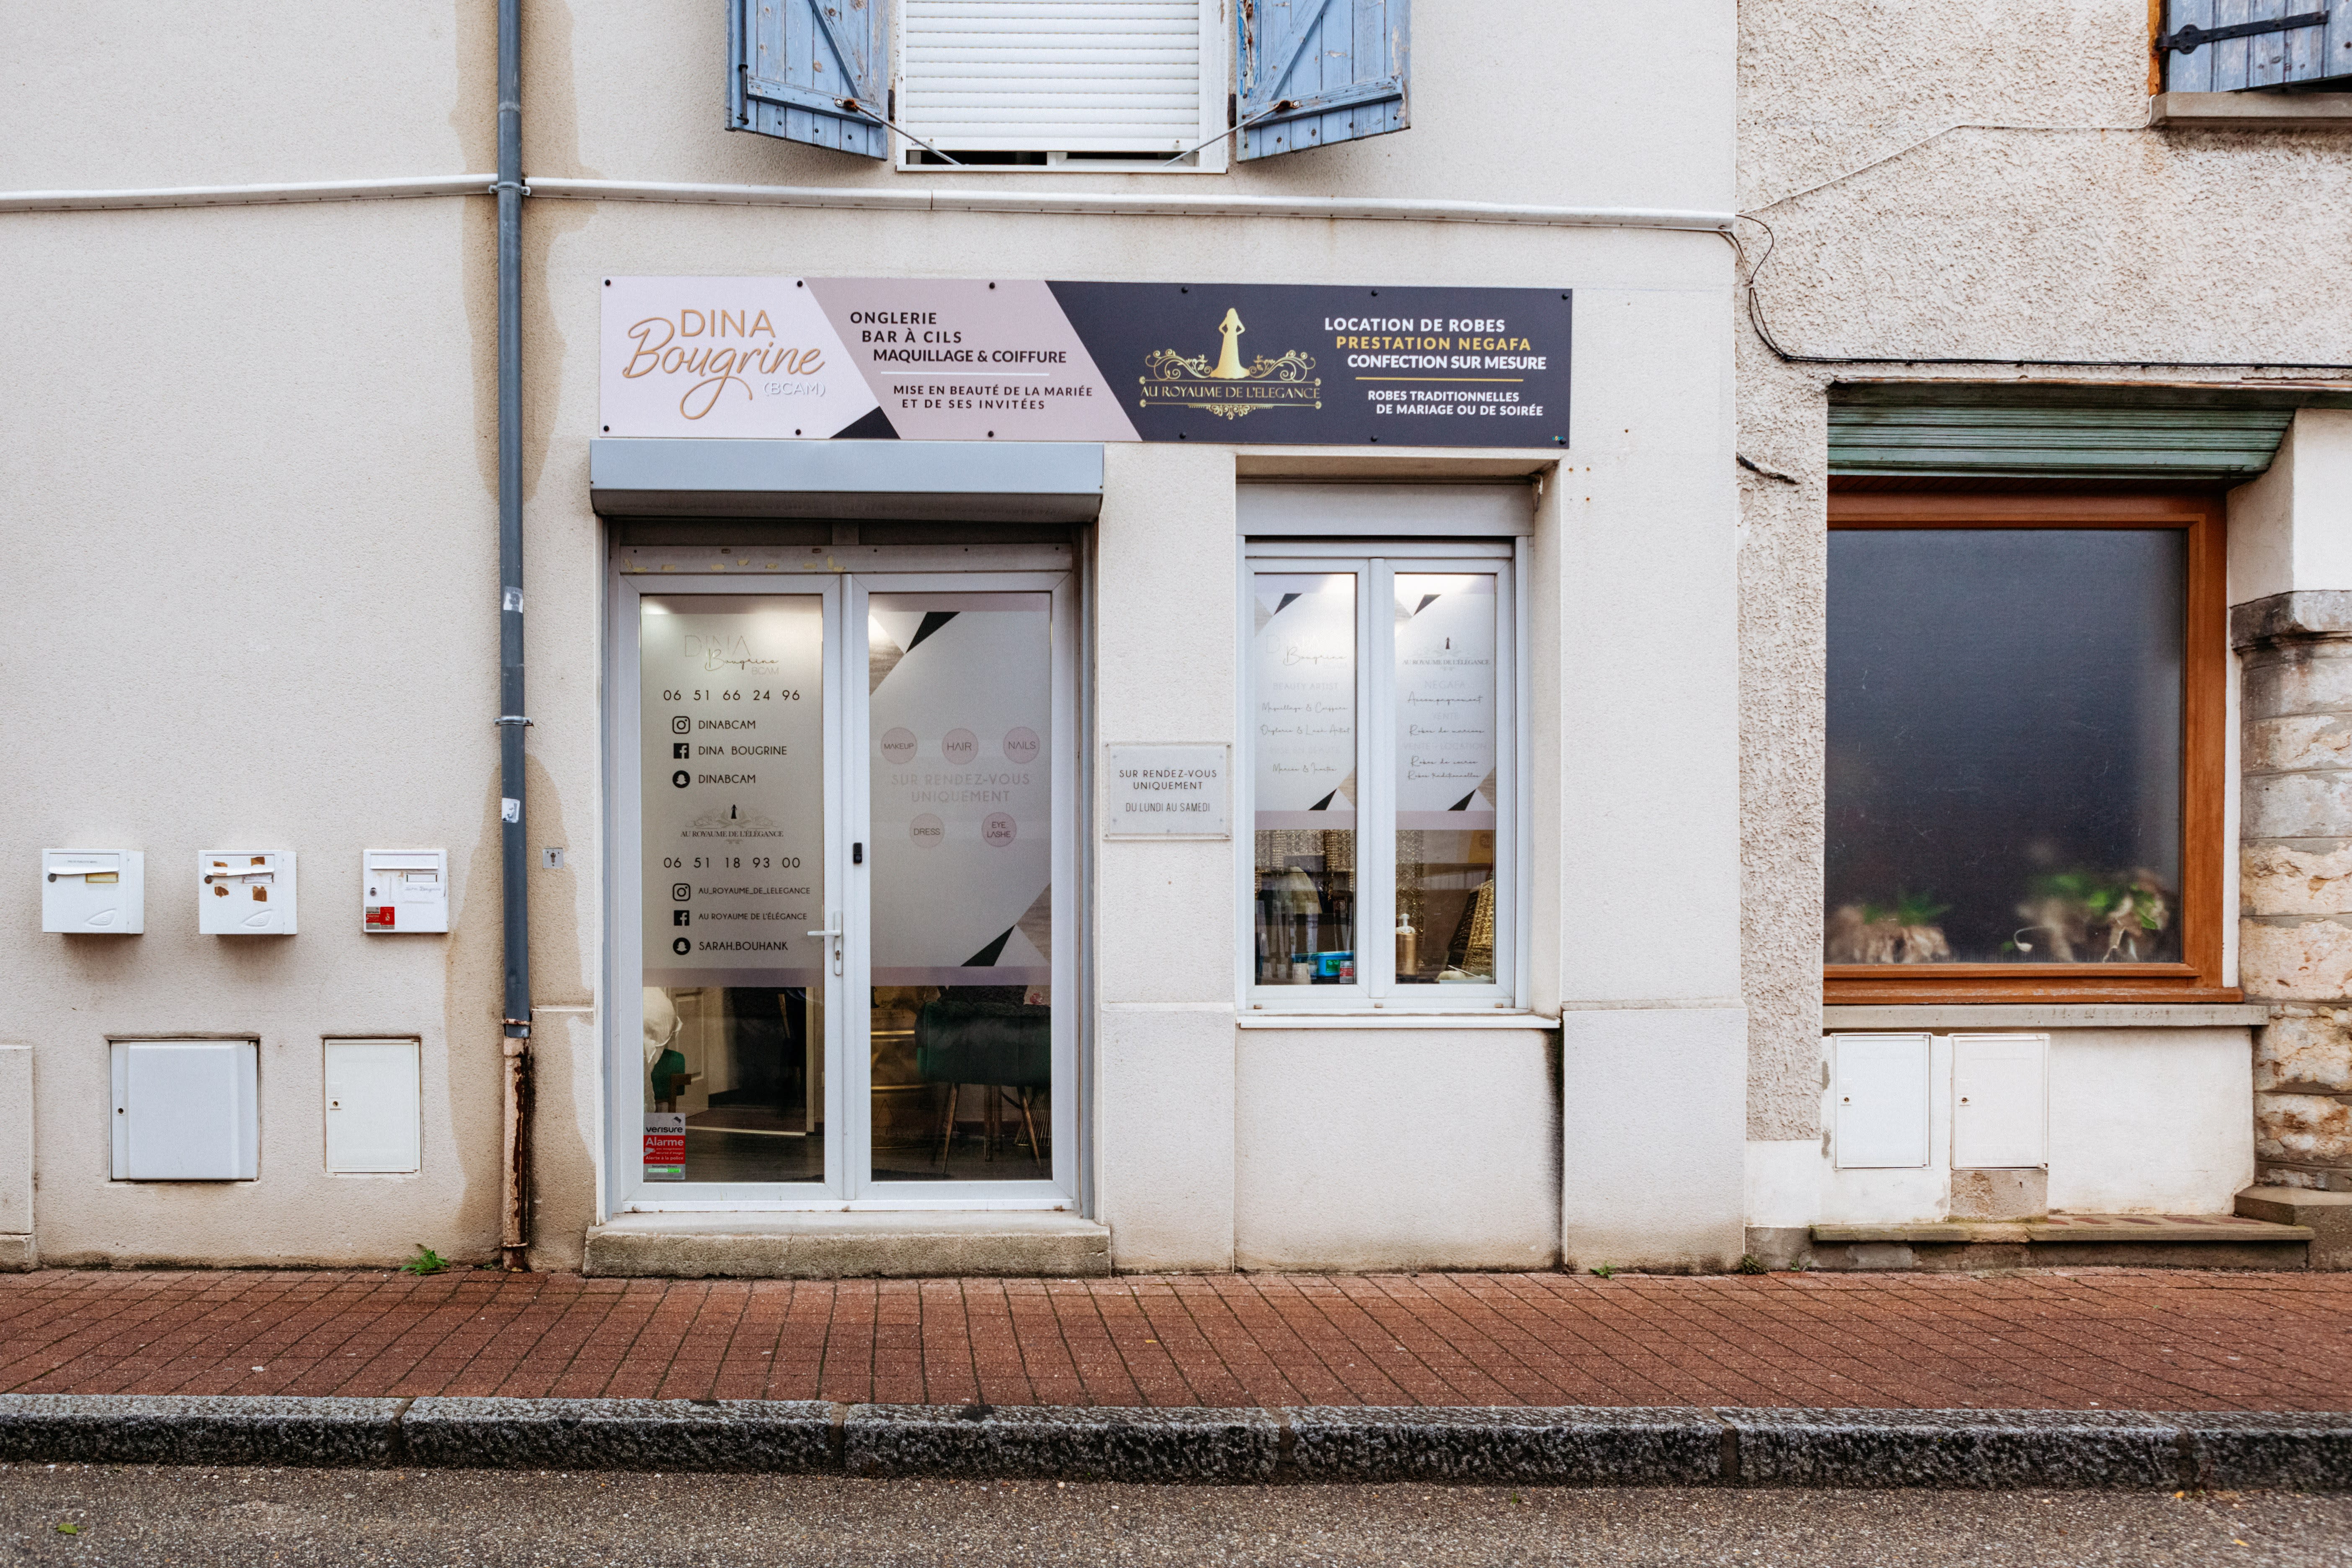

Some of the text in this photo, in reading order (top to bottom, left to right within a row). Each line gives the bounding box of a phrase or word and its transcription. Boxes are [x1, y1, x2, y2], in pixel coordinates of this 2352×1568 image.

[680, 309, 776, 338] DINA
[851, 312, 936, 324] ONGLERIE
[1325, 318, 1505, 332] LOCATION DE ROBES
[862, 328, 961, 343] BAR À CILS
[1337, 336, 1530, 351] PRESTATION NEGAFA
[874, 349, 1066, 363] MAQUILLAGE & COIFFURE
[1348, 355, 1546, 369] CONFECTION SUR MESURE
[622, 317, 825, 420] Bougrine
[763, 382, 825, 397] (BCAM)
[894, 384, 1092, 396] MISE EN BEAUTÉ DE LA MARIÉE
[1141, 386, 1320, 399] AU ROYAUME DE L'ELEGANCE
[1368, 391, 1519, 402] ROBES TRADITIONNELLES
[903, 398, 1044, 409] ET DE SES INVITÉES
[1377, 404, 1543, 415] DE MARIAGE OU DE SOIRÉE
[685, 635, 751, 657] DINA
[663, 690, 799, 701] 06 51 66 24 96
[699, 720, 755, 729] DINABCAM
[699, 746, 787, 755] DINA BOUGRINE
[699, 774, 755, 783] DINABCAM
[892, 774, 1030, 785] SUR RENDEZ-VOUS
[1133, 782, 1203, 790] UNIQUEMENT
[911, 791, 1010, 803] UNIQUEMENT
[1126, 803, 1210, 812] DU LUNDI AU SAMEDI
[664, 857, 800, 868] 06 51 18 93 00
[699, 941, 788, 950] SARAH.BOUHANK
[646, 1137, 683, 1146] Alarme
